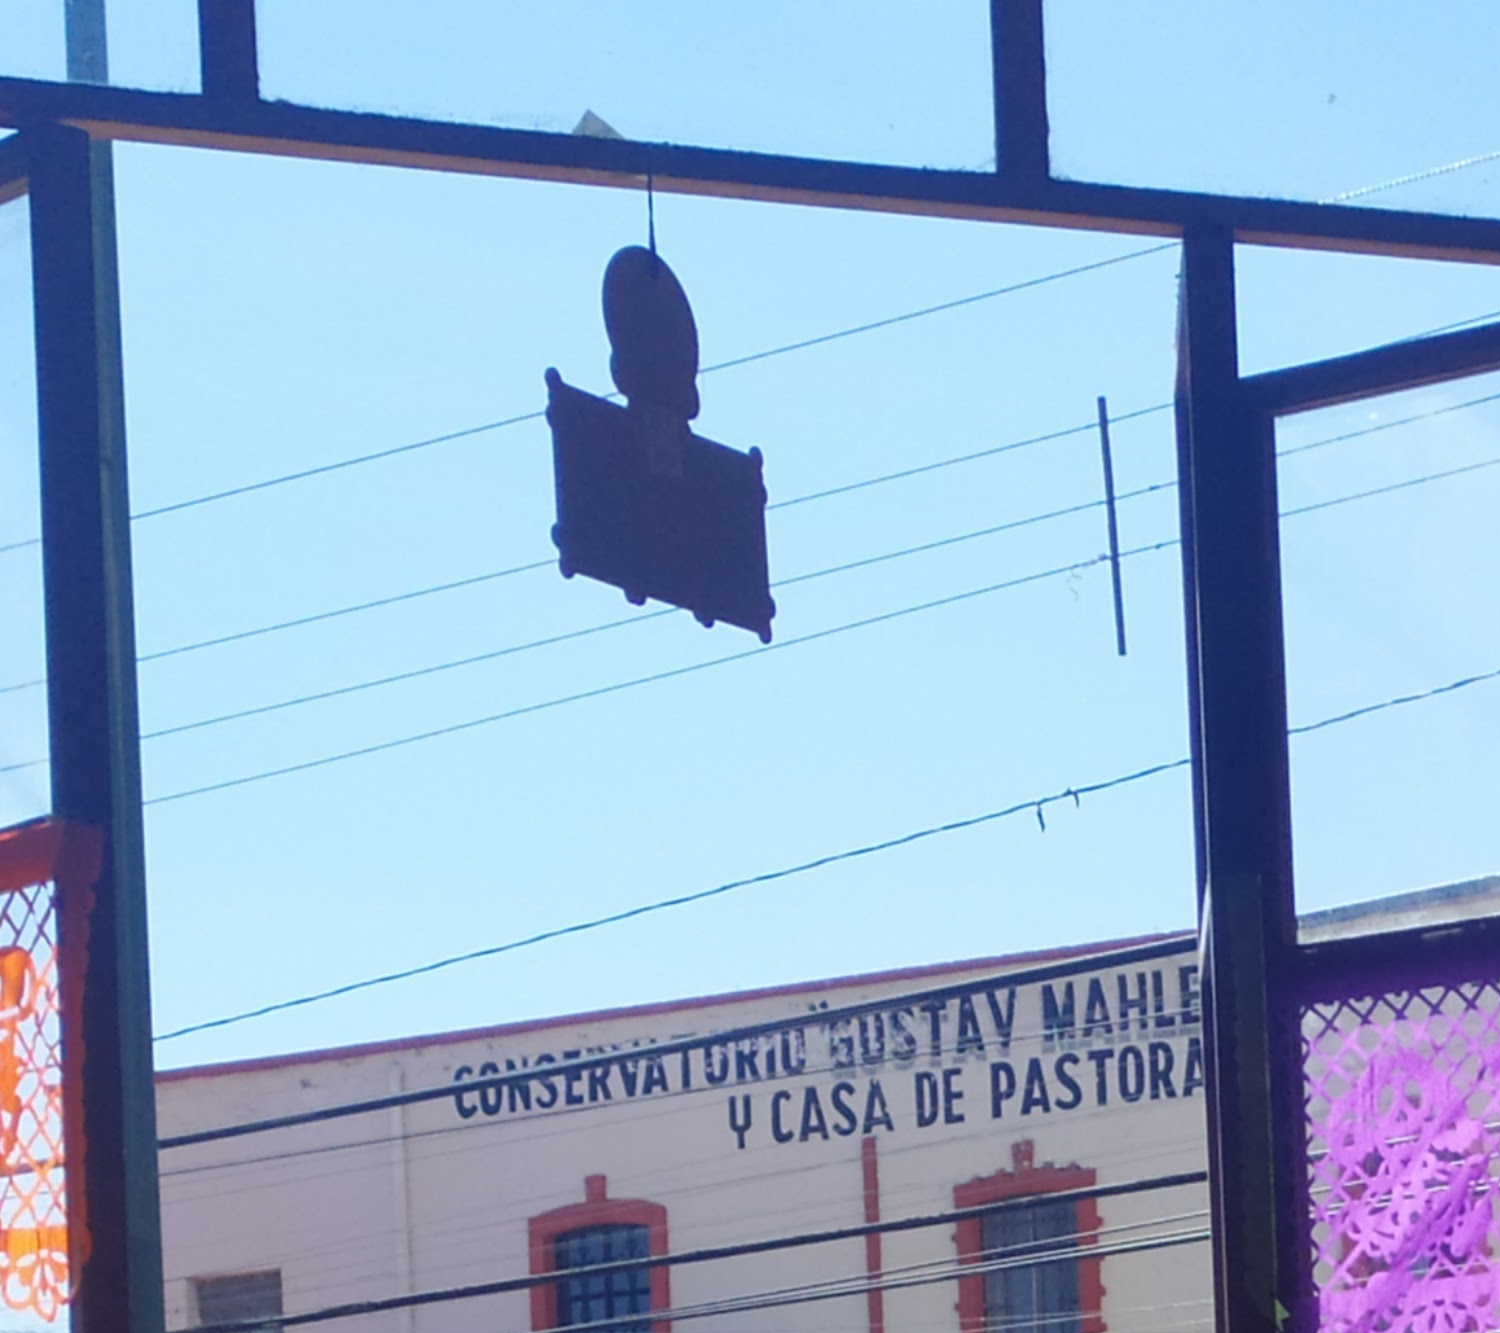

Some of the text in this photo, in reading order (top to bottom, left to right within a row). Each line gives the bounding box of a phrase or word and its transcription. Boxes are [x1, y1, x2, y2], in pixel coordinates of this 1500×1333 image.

[1040, 964, 1201, 1044] MAHLE
[729, 1036, 1204, 1149] Y CASA DE PASTORA
